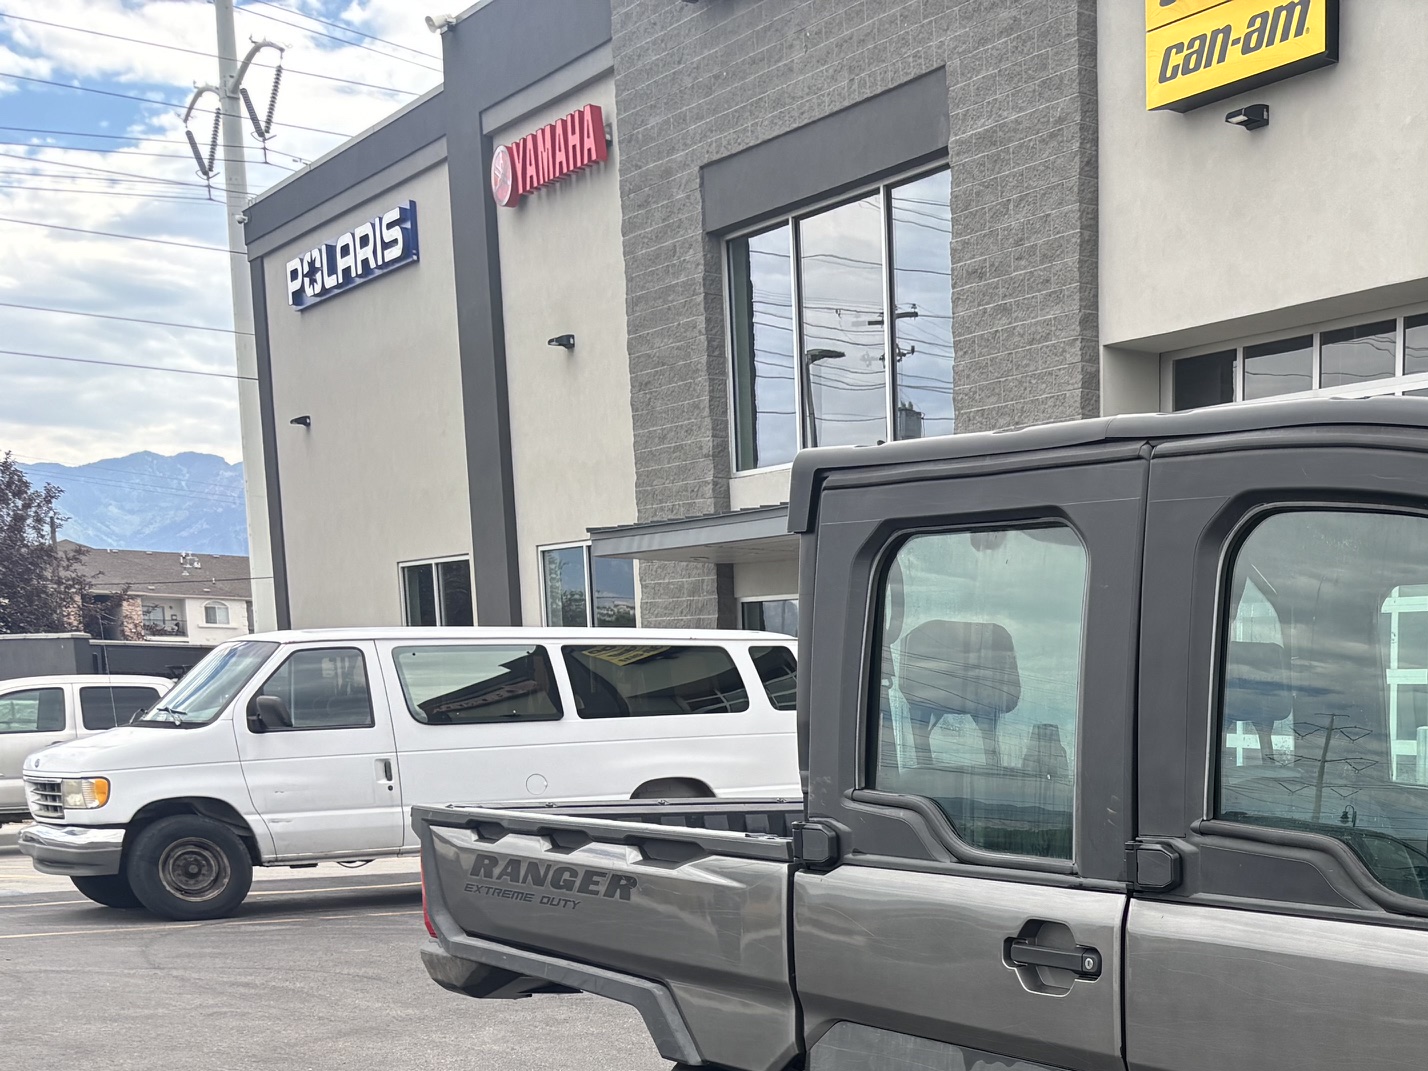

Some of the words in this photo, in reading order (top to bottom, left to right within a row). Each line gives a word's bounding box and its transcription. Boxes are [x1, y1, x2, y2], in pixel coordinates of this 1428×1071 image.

[512, 105, 597, 194] YAMAHA
[286, 207, 403, 305] POLARIS
[464, 883, 536, 903] EXTREME
[539, 895, 581, 910] DUTY
[469, 853, 638, 901] RANGER
